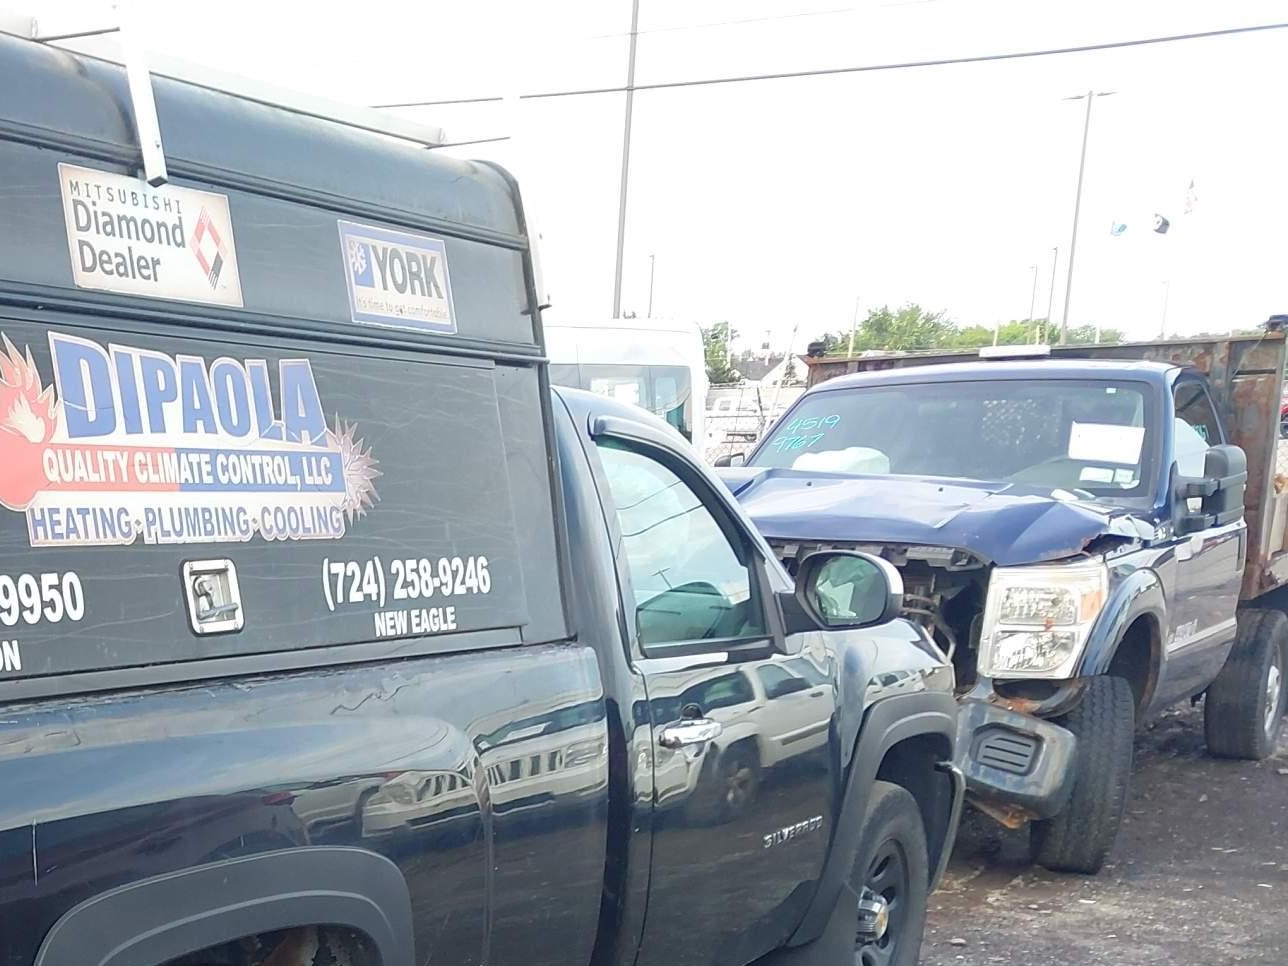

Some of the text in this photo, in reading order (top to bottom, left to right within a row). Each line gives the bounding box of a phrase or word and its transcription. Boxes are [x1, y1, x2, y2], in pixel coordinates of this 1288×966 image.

[69, 179, 182, 215] MITSUBISHI
[72, 198, 186, 248] Diamond
[77, 239, 161, 282] Dealer
[371, 244, 444, 299] YORK
[52, 338, 328, 448] DIPAOLA
[42, 447, 333, 490] QUALITY CLIMATE CONTROL, LLC
[322, 556, 491, 611] (724) 258-9246
[374, 606, 457, 637] NEW EAGLE
